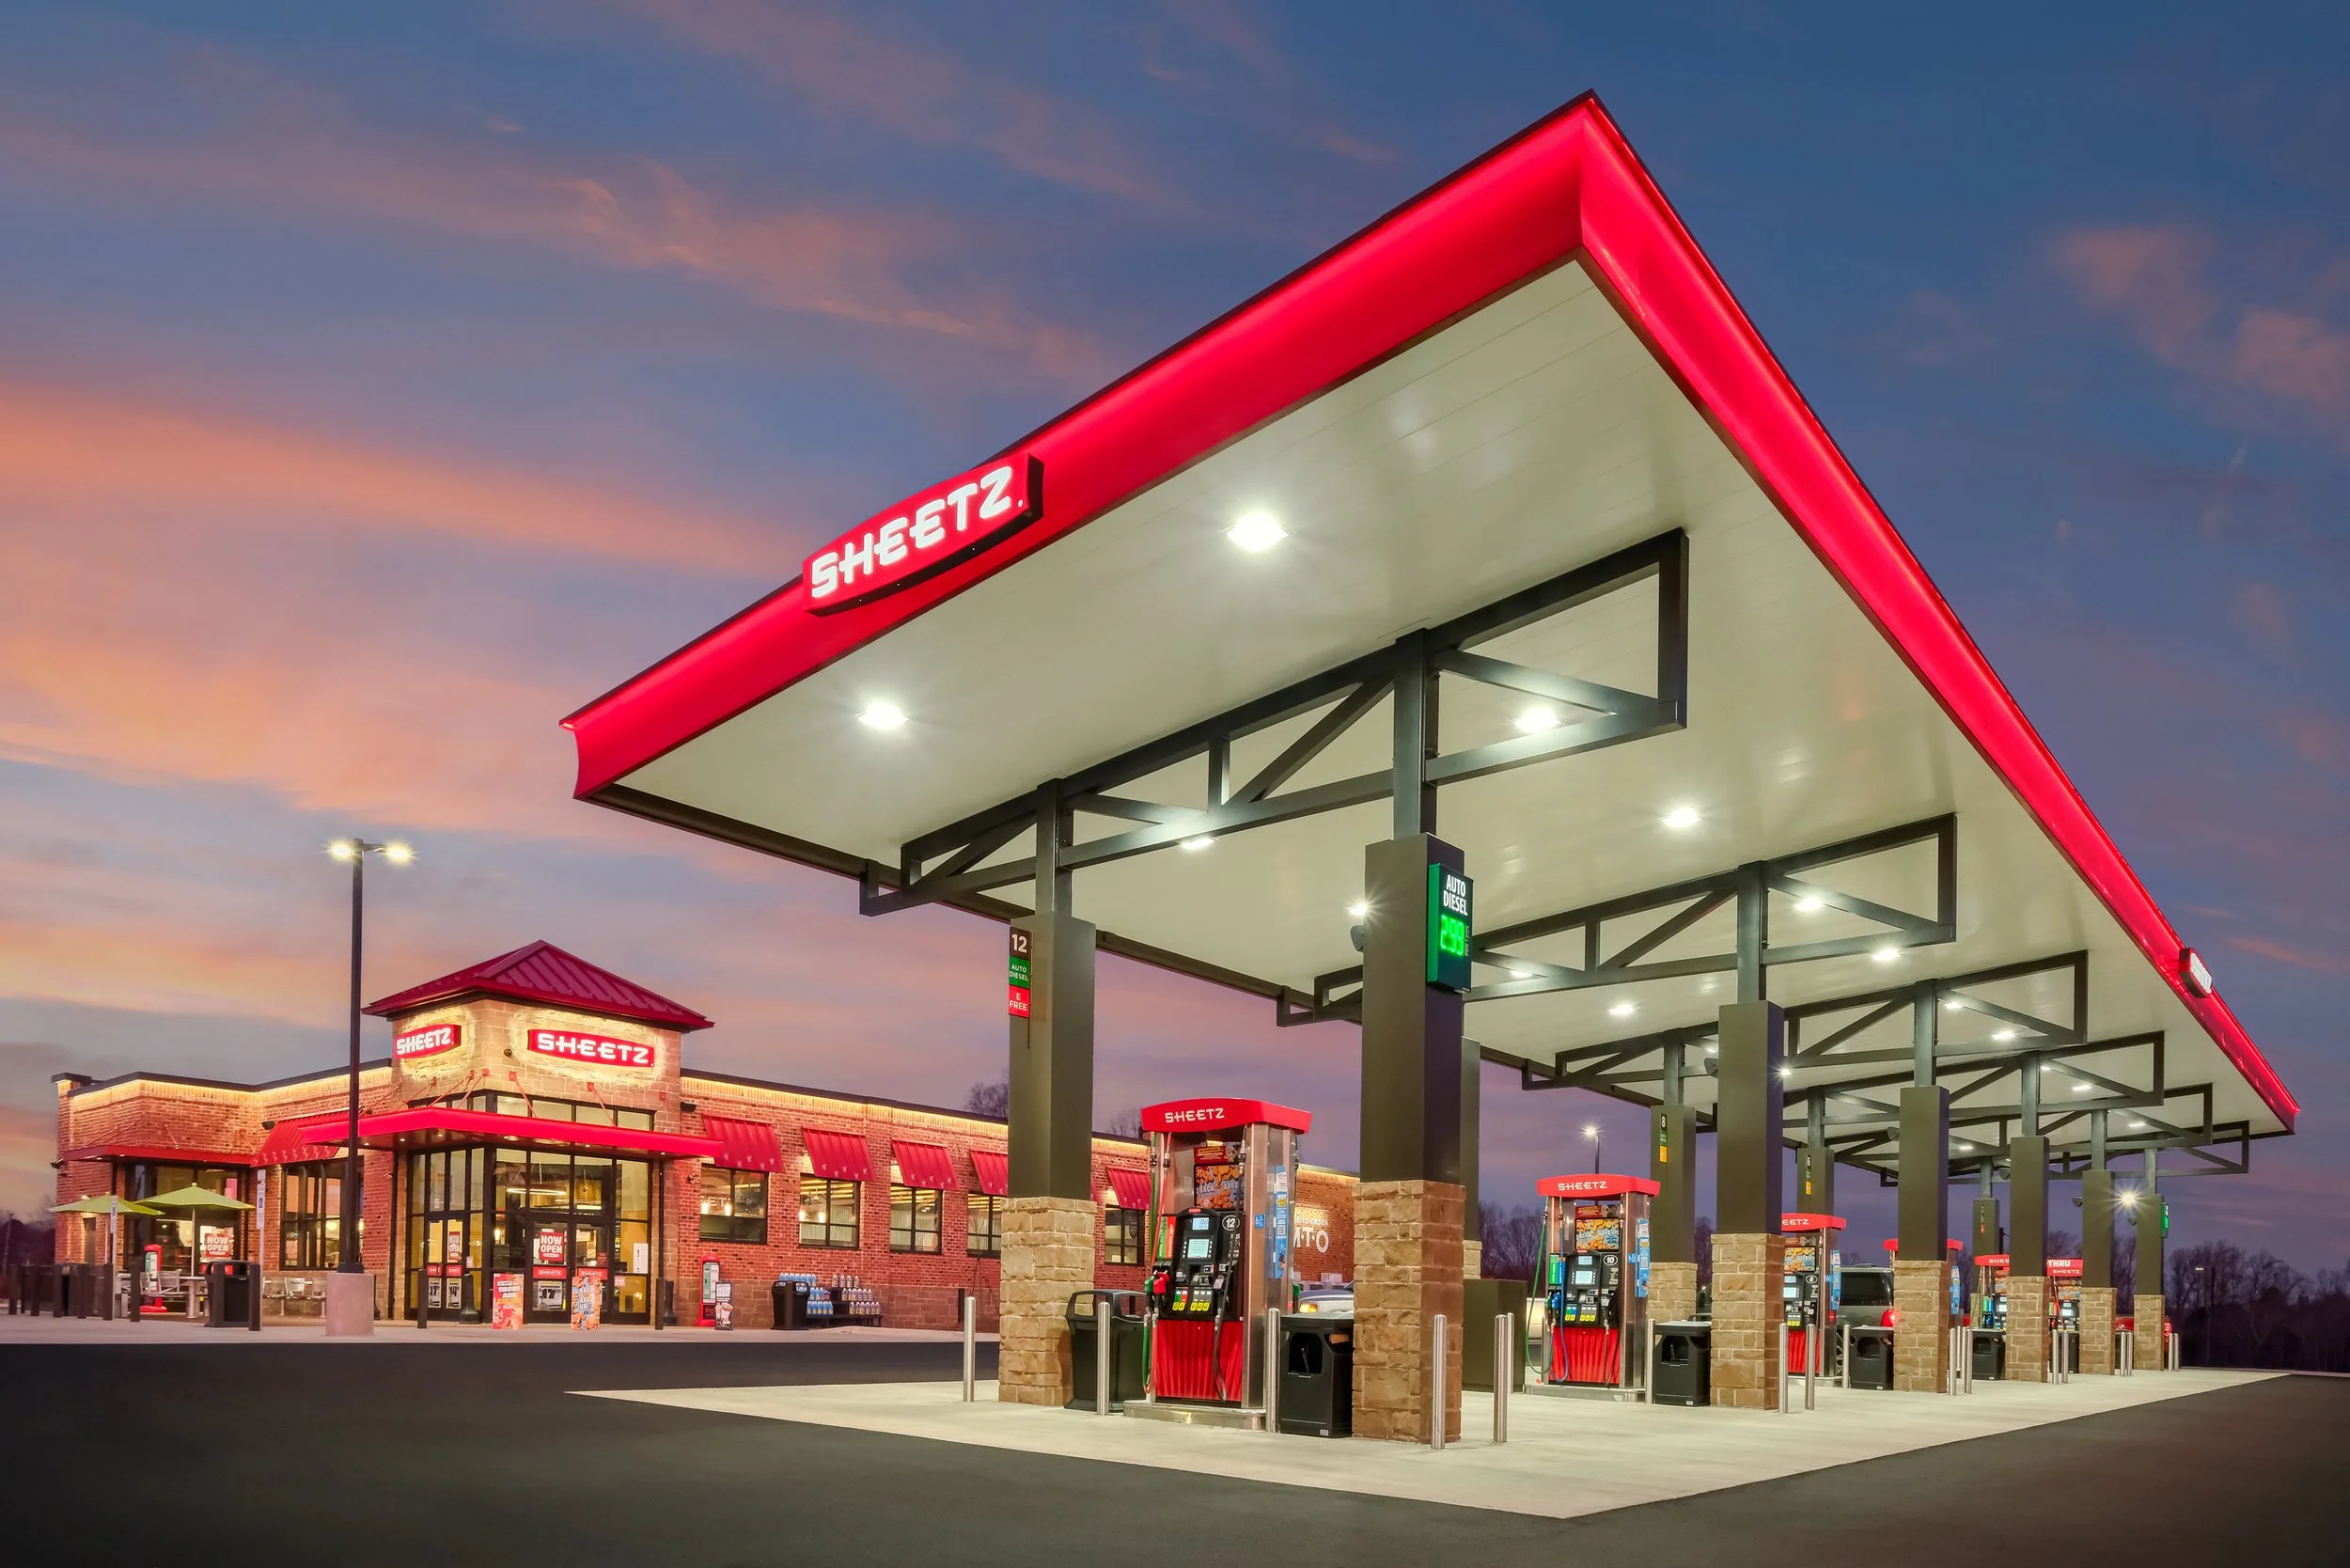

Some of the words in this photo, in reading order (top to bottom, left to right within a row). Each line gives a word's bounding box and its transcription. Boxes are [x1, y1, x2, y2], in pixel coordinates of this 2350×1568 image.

[811, 465, 1012, 599] SHEETZ
[1446, 874, 1466, 897] AUTO
[1443, 889, 1468, 916] DIESEL
[1011, 933, 1027, 953] 12
[1011, 964, 1026, 973] AUTO
[1009, 971, 1028, 980] DIESEL
[1016, 993, 1021, 1001] E
[1009, 1000, 1027, 1011] FREE
[396, 1027, 451, 1055] SHEETZ
[537, 1033, 649, 1064] SHEETZ
[1165, 1107, 1225, 1123] SHEETZ
[1661, 1116, 1666, 1128] 8
[1557, 1181, 1607, 1191] SHEETZ
[1226, 1217, 1235, 1229] 12
[540, 1235, 563, 1245] NOW
[540, 1245, 562, 1254] OPEN
